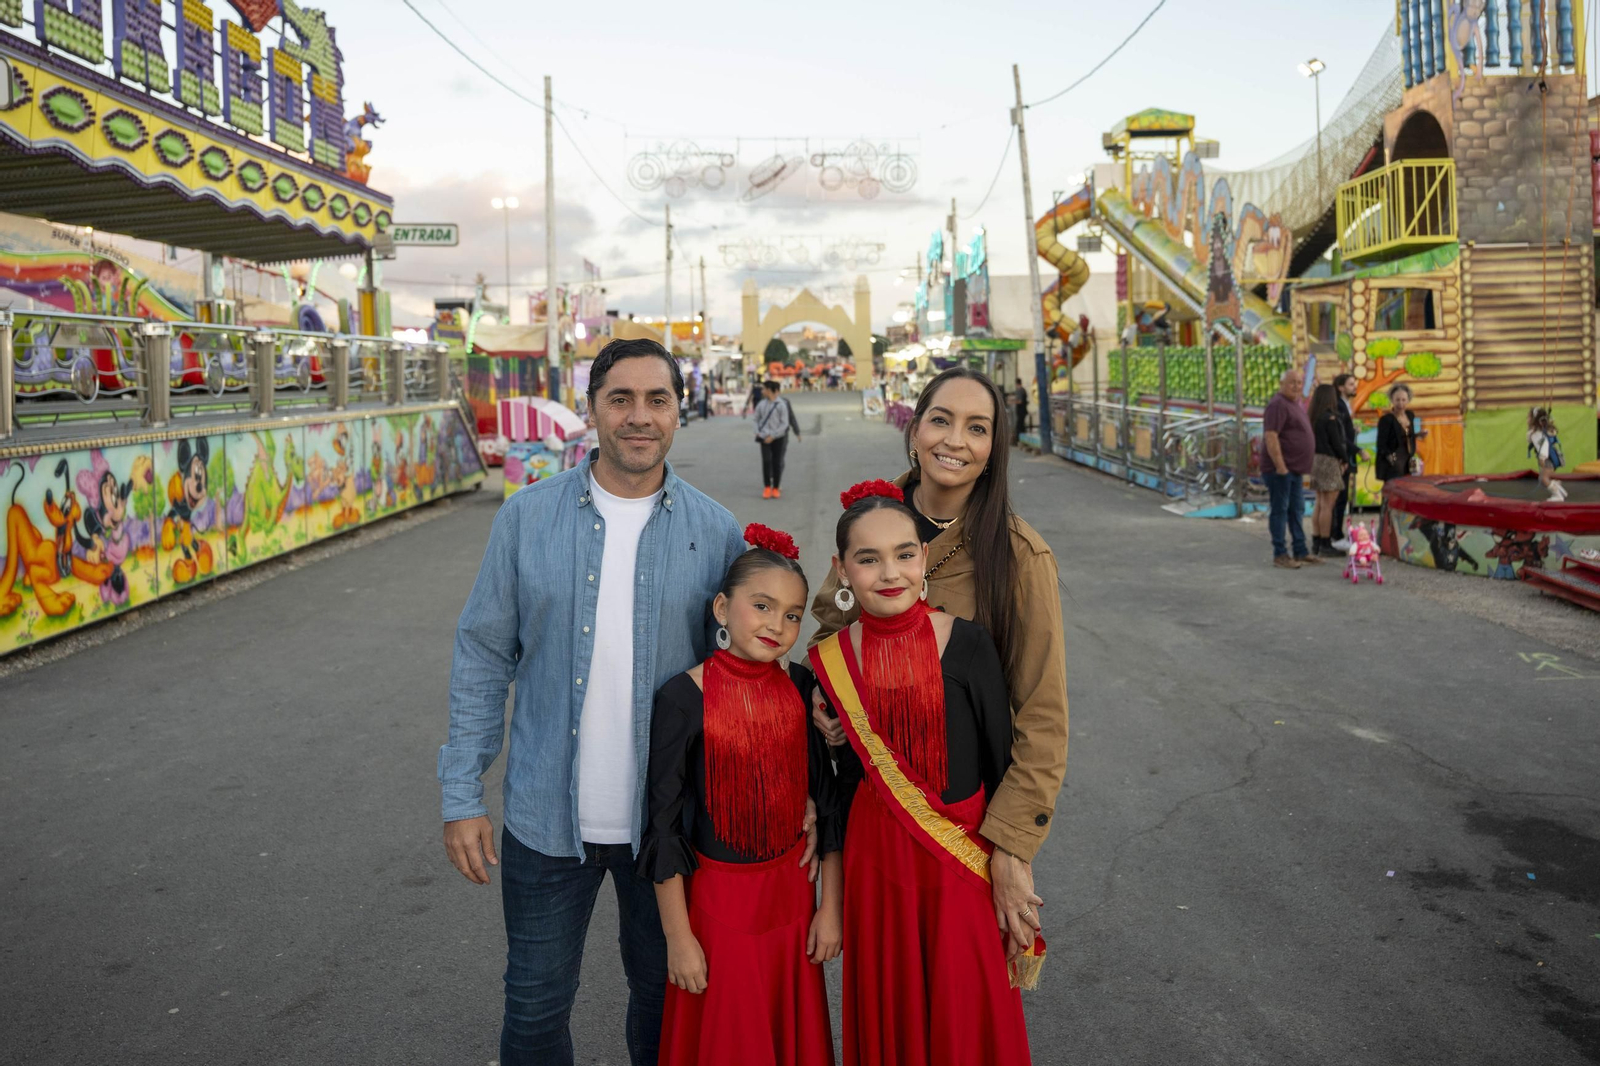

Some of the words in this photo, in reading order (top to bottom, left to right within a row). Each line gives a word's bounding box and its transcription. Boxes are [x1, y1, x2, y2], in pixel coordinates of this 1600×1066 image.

[51, 229, 81, 248] SUPER
[393, 228, 452, 242] ENTRADA
[937, 824, 970, 857] Albox
[966, 846, 988, 870] 2024
